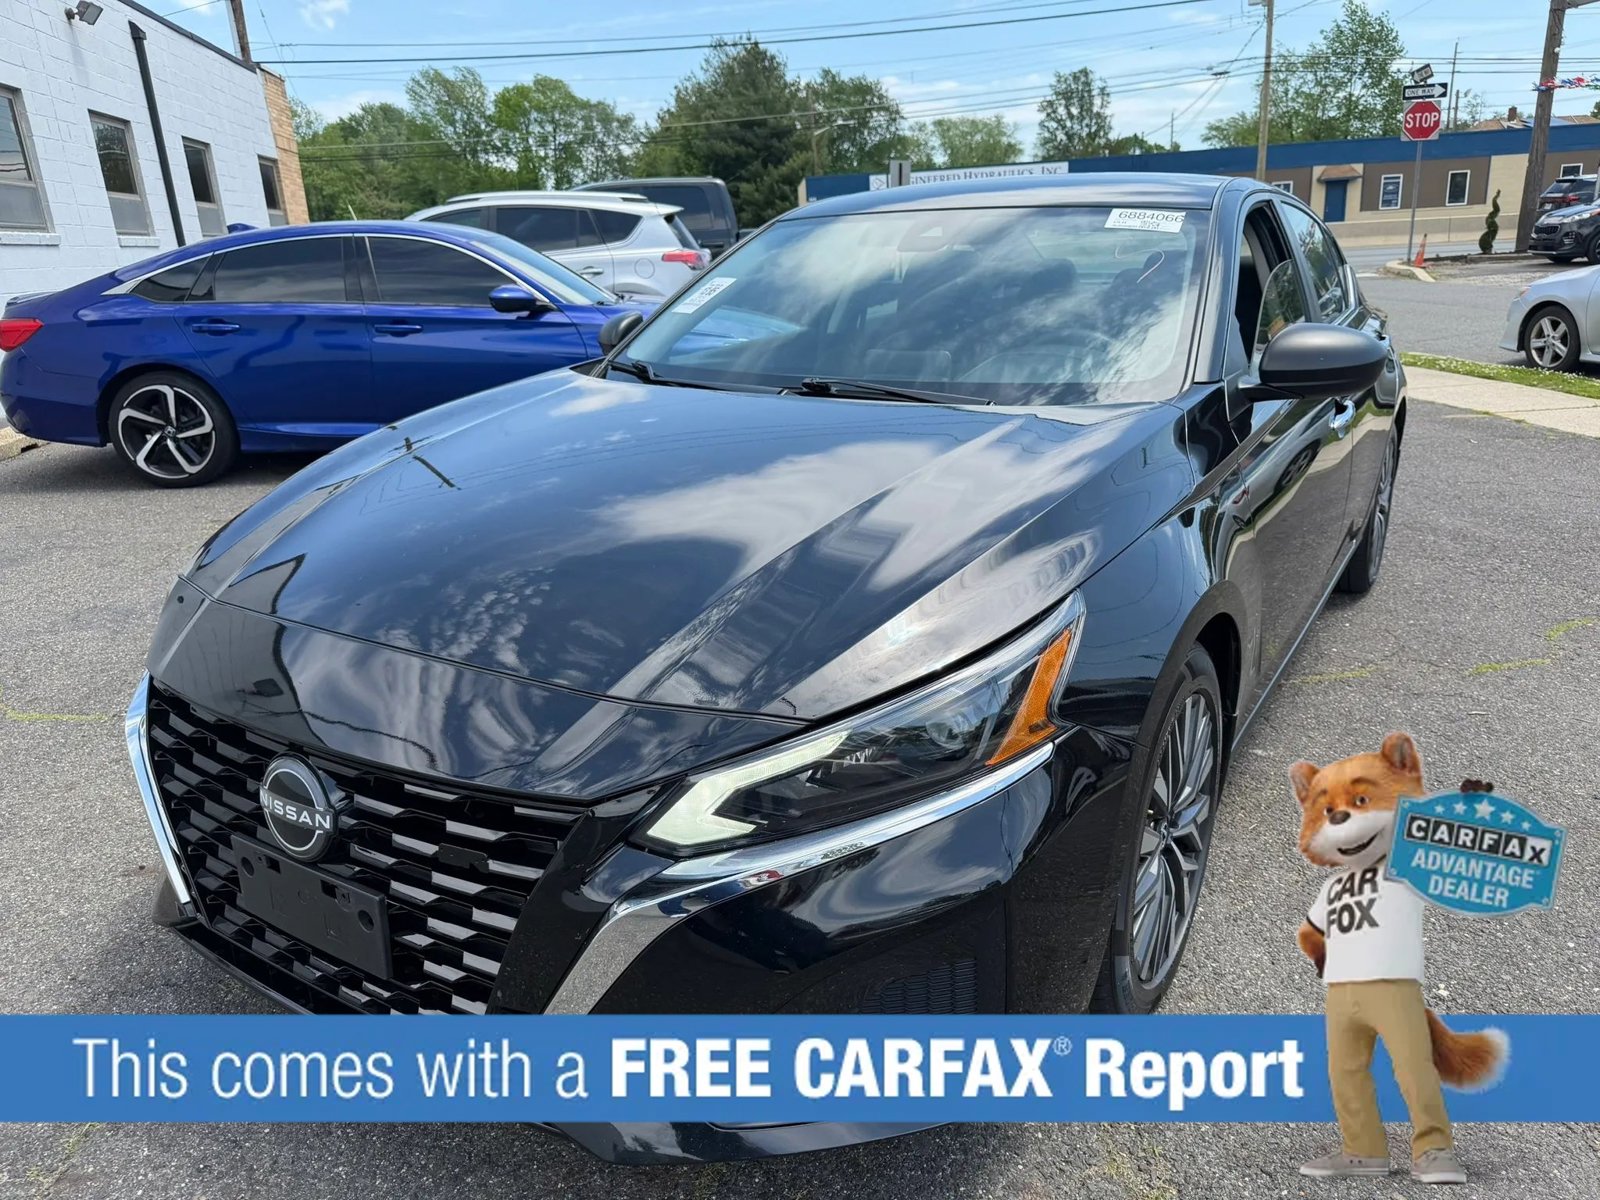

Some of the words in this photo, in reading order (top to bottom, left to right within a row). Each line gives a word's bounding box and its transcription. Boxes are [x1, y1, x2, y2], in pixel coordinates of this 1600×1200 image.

[1406, 112, 1439, 128] STOP
[1118, 211, 1184, 222] 6884066
[259, 787, 331, 829] NISSAN
